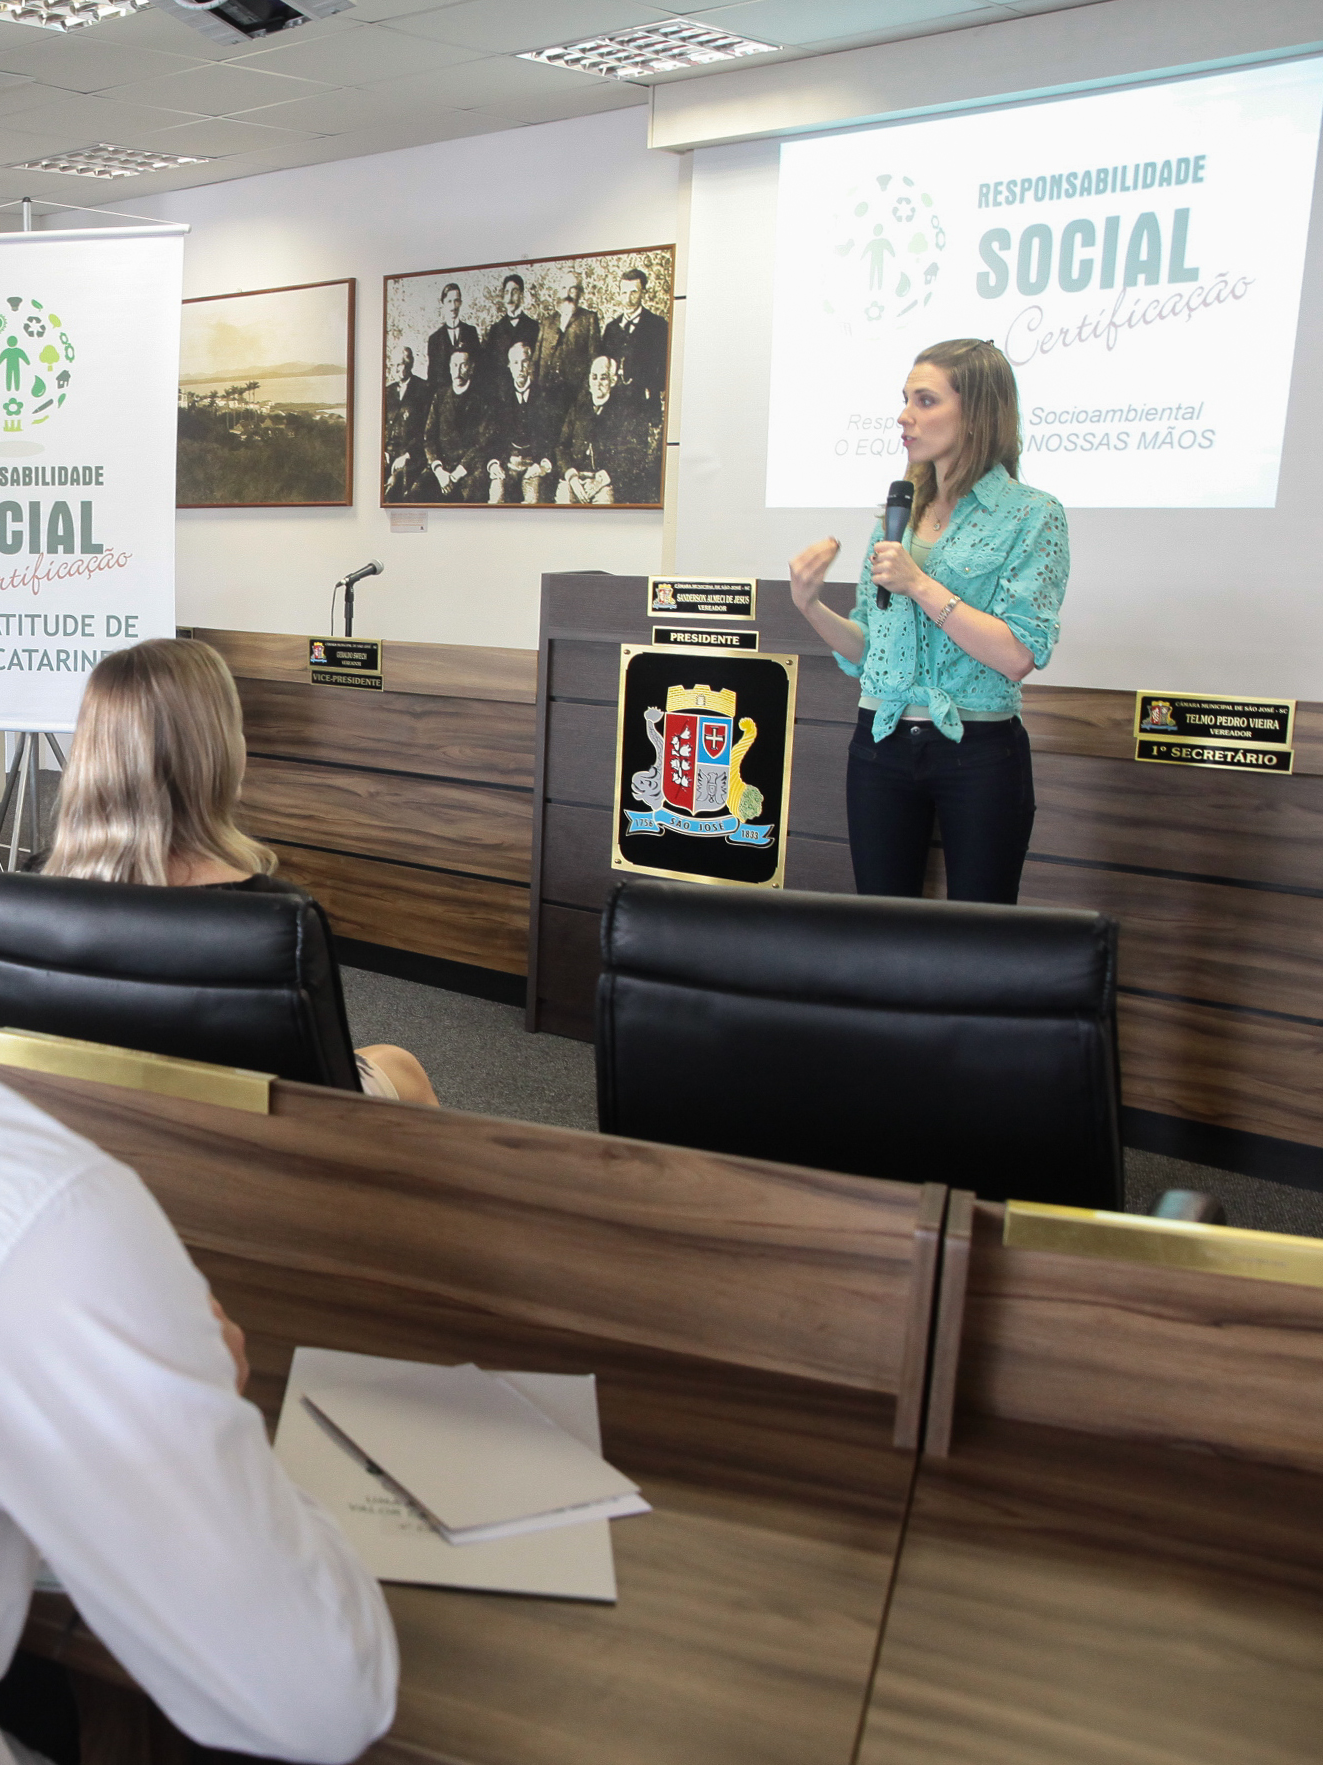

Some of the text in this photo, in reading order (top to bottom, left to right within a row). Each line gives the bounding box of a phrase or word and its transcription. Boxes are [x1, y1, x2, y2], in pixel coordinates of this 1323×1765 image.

[977, 154, 1207, 209] RESPONSABILIDADE
[976, 206, 1200, 300] SOCIAL
[1004, 270, 1257, 367] Certificação
[1028, 401, 1205, 427] Socioambiental
[834, 438, 849, 456] O
[1026, 432, 1131, 453] NOSSAS
[1137, 426, 1216, 452] MÃOS
[697, 604, 727, 612] VEREADOR
[105, 614, 139, 638] DE
[670, 632, 740, 645] PRESIDENTE
[312, 673, 381, 687] VICE-PRESIDENTE
[1175, 701, 1200, 709] CÂMARA
[1201, 703, 1233, 711] MUNICIPAL
[1185, 713, 1280, 730] TELMO PEDRO VIEIRA
[1209, 728, 1253, 738] VEREADOR
[1170, 746, 1278, 766] SECRETÁRIO
[741, 829, 759, 840] 1833
